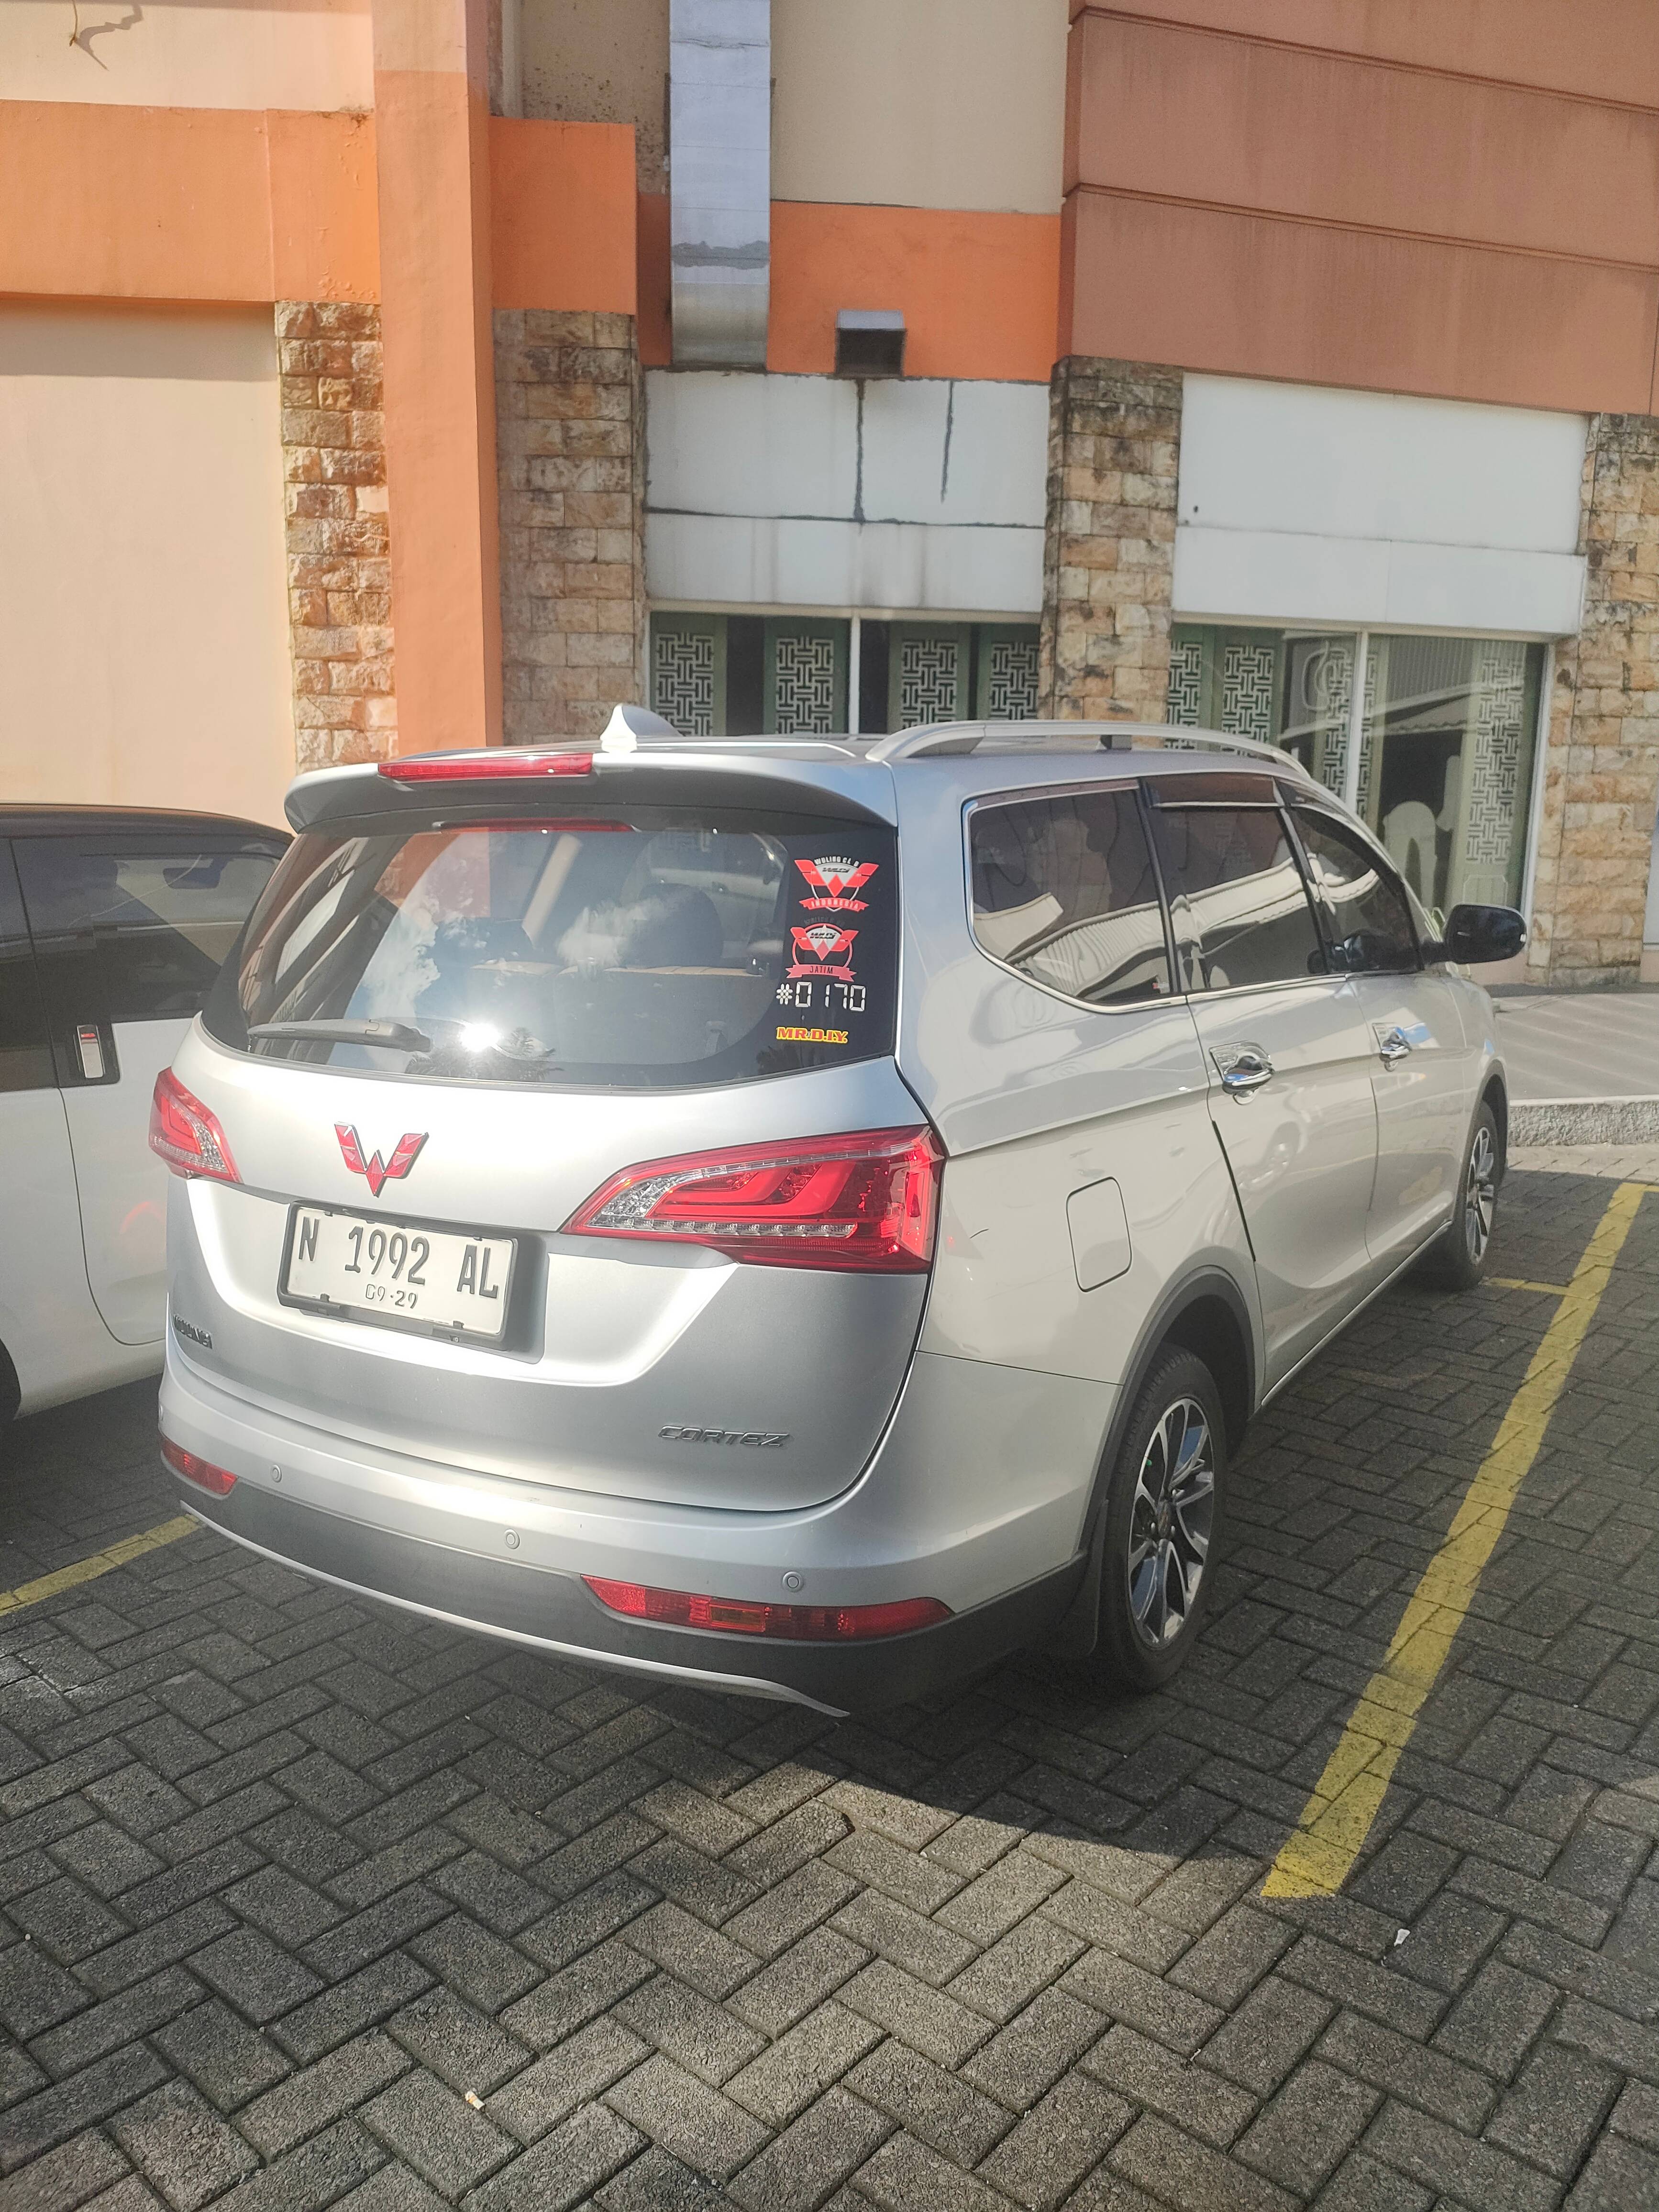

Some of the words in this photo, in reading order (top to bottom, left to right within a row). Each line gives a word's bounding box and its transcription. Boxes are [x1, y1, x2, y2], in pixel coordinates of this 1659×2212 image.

[811, 899, 859, 909] INDONESIA
[299, 1217, 320, 1261] N
[345, 1226, 430, 1285] 1992
[456, 1244, 498, 1299] AL
[658, 1425, 789, 1447] CORTEZ
